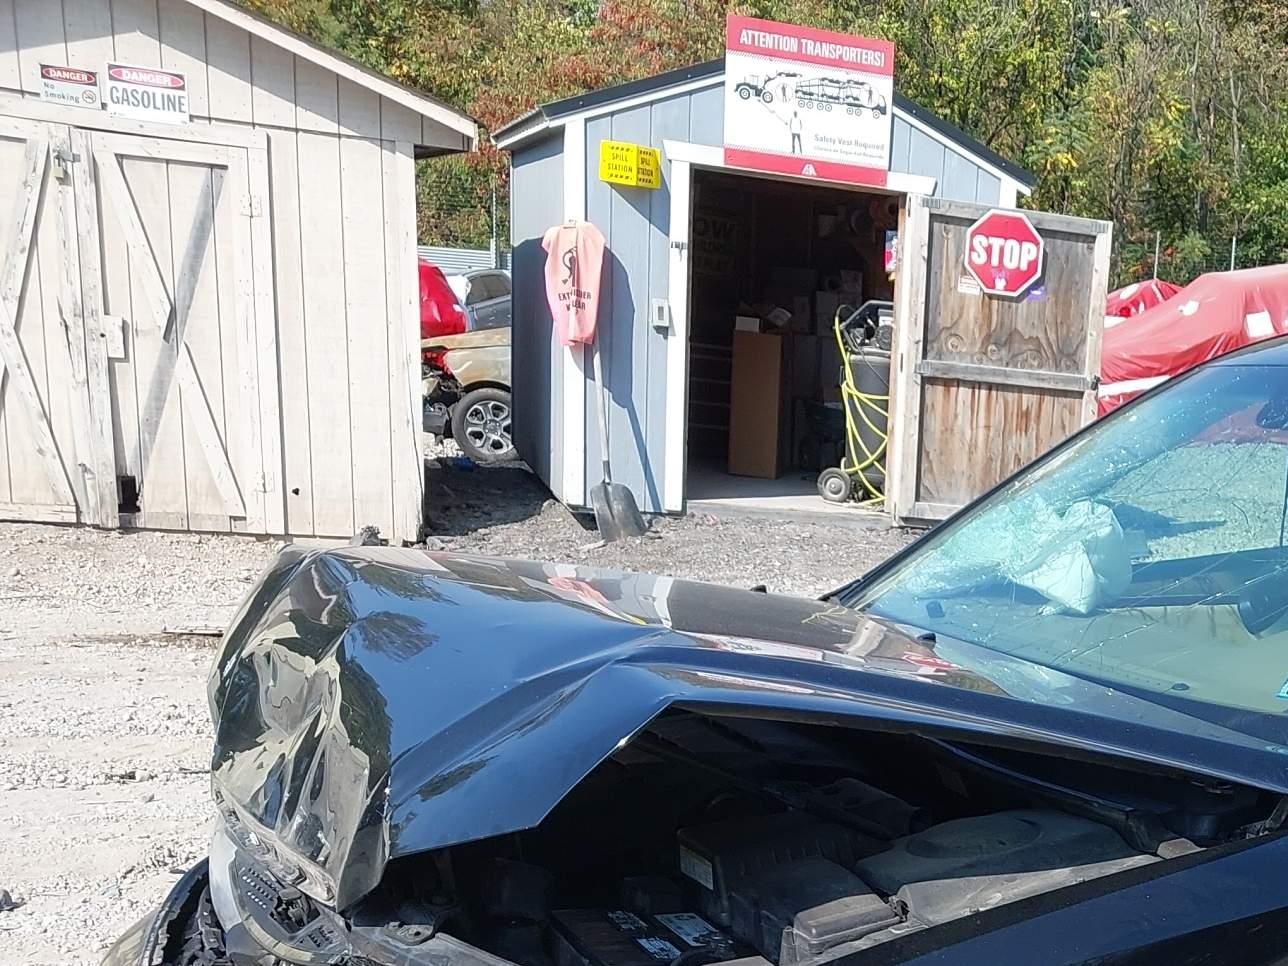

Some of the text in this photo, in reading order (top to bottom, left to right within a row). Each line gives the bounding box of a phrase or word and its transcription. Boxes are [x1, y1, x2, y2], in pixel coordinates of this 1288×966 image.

[739, 29, 885, 67] ATTENTION TRANSPORTERS!
[49, 68, 88, 82] DANGER
[122, 66, 172, 86] DANGER
[43, 81, 55, 89] No
[44, 90, 80, 104] Smoking
[109, 85, 186, 114] GASOLINE
[611, 152, 629, 162] SPILL
[607, 163, 633, 173] STATION
[970, 233, 1038, 272] STOP
